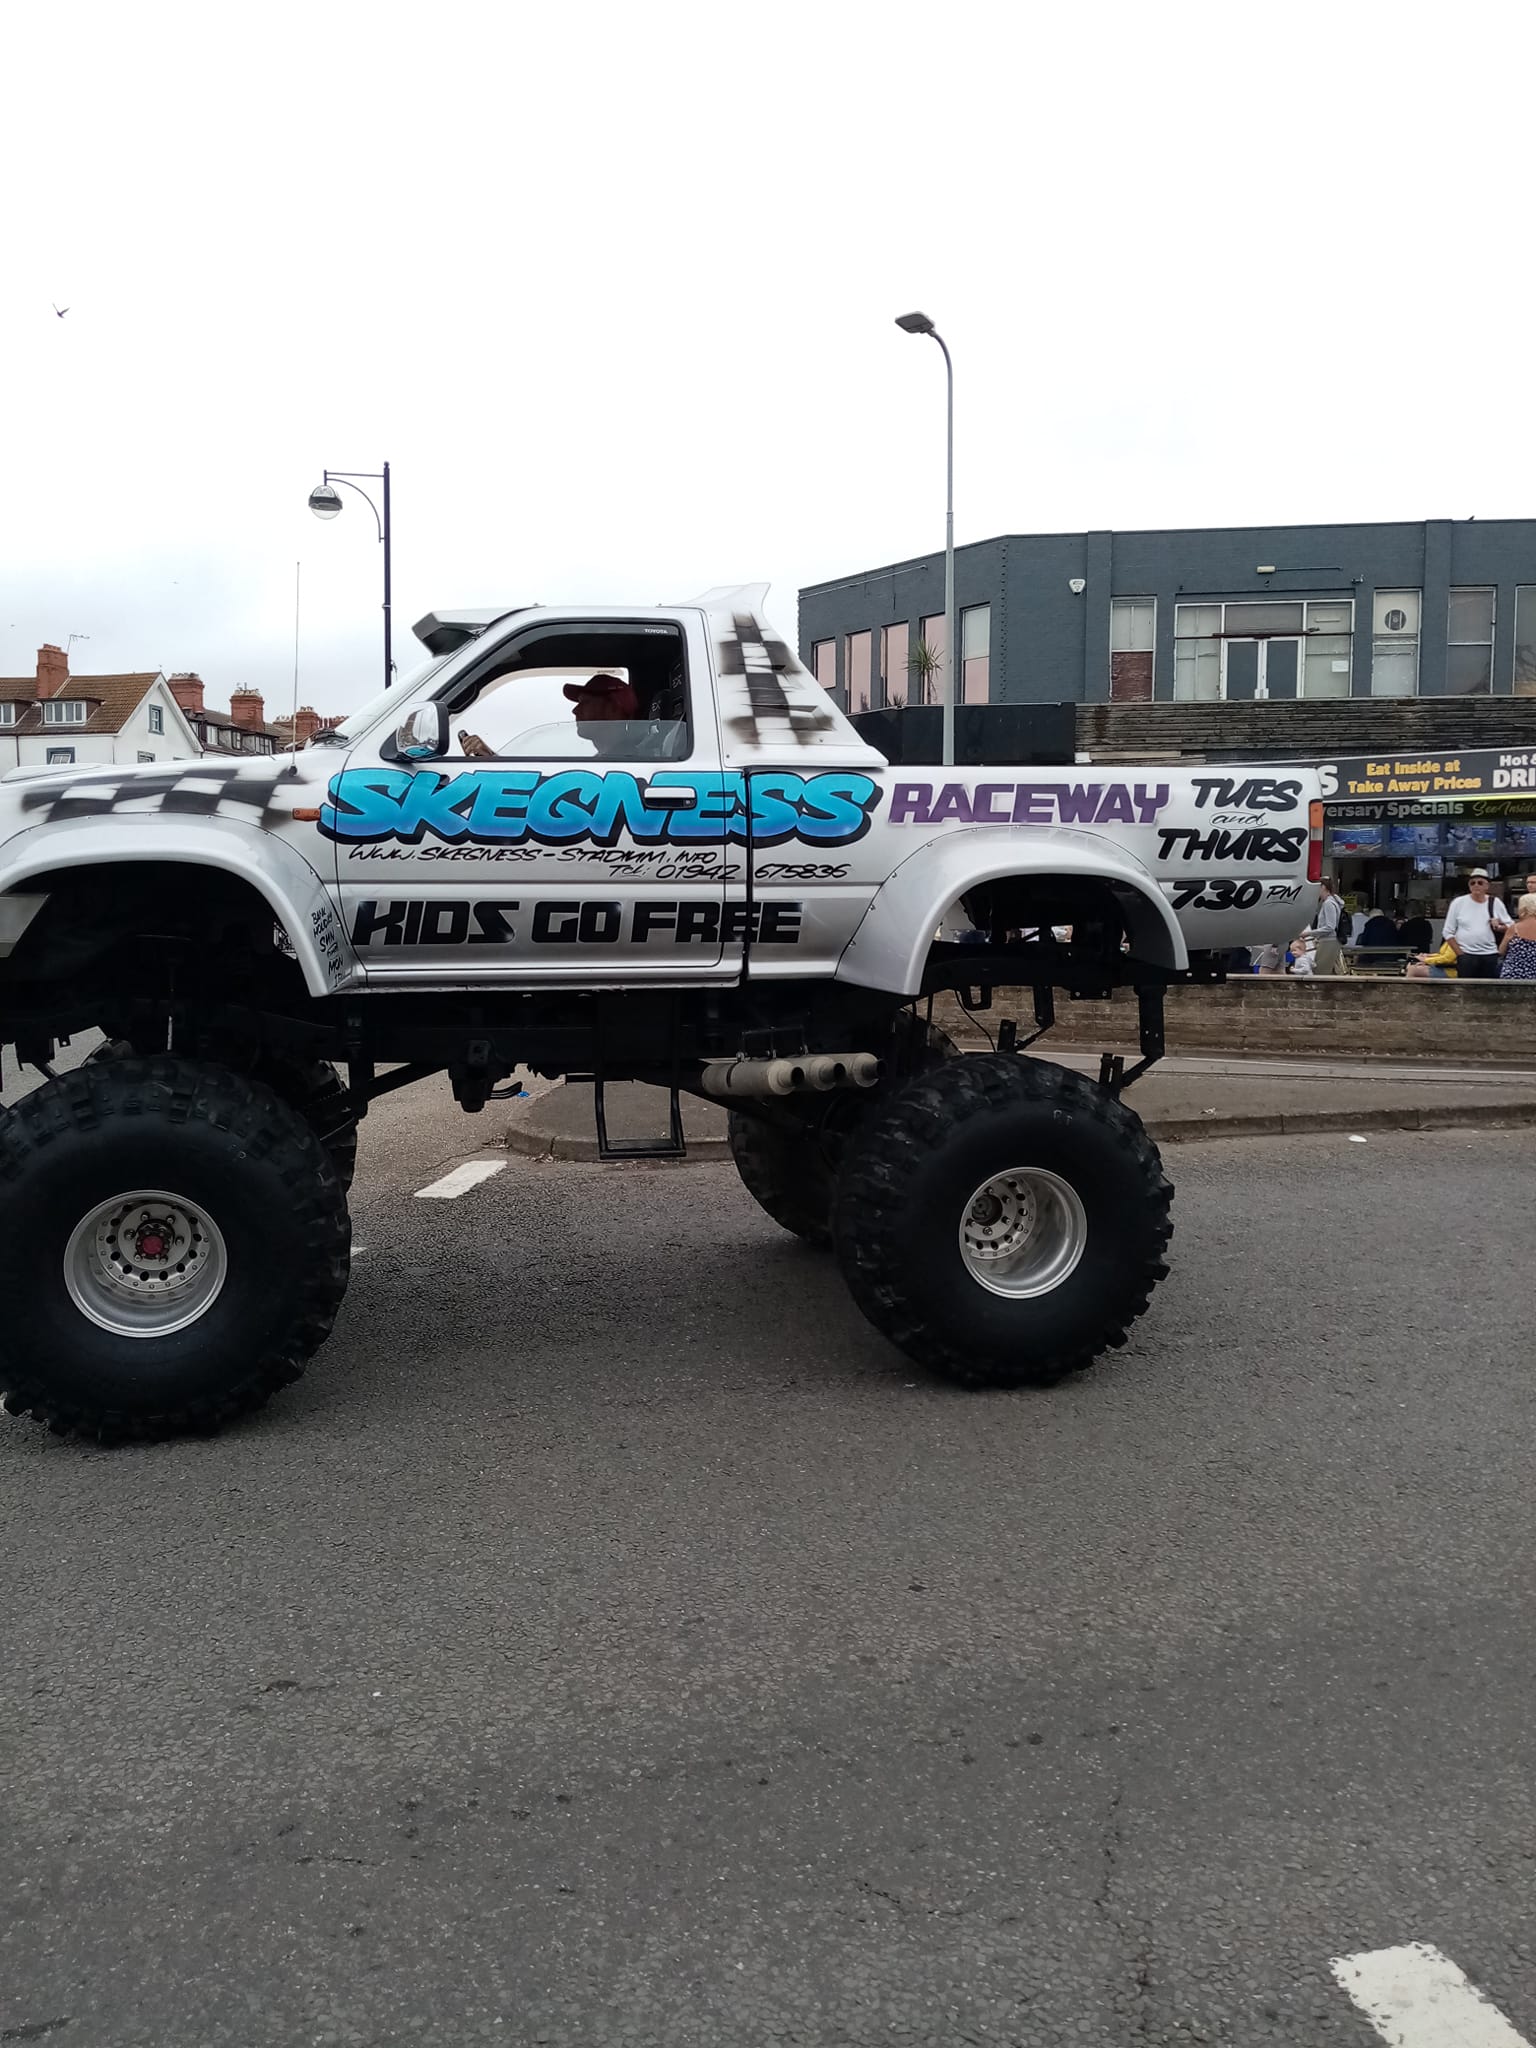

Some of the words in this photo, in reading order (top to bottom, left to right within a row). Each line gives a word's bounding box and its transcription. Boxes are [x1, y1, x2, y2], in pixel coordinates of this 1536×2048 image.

[1366, 762, 1391, 776] Eat
[1394, 760, 1441, 775] Inside
[1444, 759, 1461, 773] at
[1499, 754, 1529, 767] Hot
[1191, 778, 1303, 812] TUES
[1347, 780, 1384, 794] Take
[1387, 779, 1430, 794] Away
[1433, 776, 1482, 791] Prices
[318, 768, 881, 845] SKEGNESS
[889, 783, 1170, 824] RACEWAY
[1386, 801, 1465, 819] Specials
[1211, 811, 1268, 827] and
[1158, 828, 1308, 863] THURS
[655, 864, 741, 880] 01942
[754, 863, 852, 879] 675836
[1172, 879, 1263, 911] 7.30
[1266, 885, 1303, 901] PM
[351, 901, 519, 945] KIDS
[532, 901, 622, 943] GO
[631, 901, 803, 943] FREE
